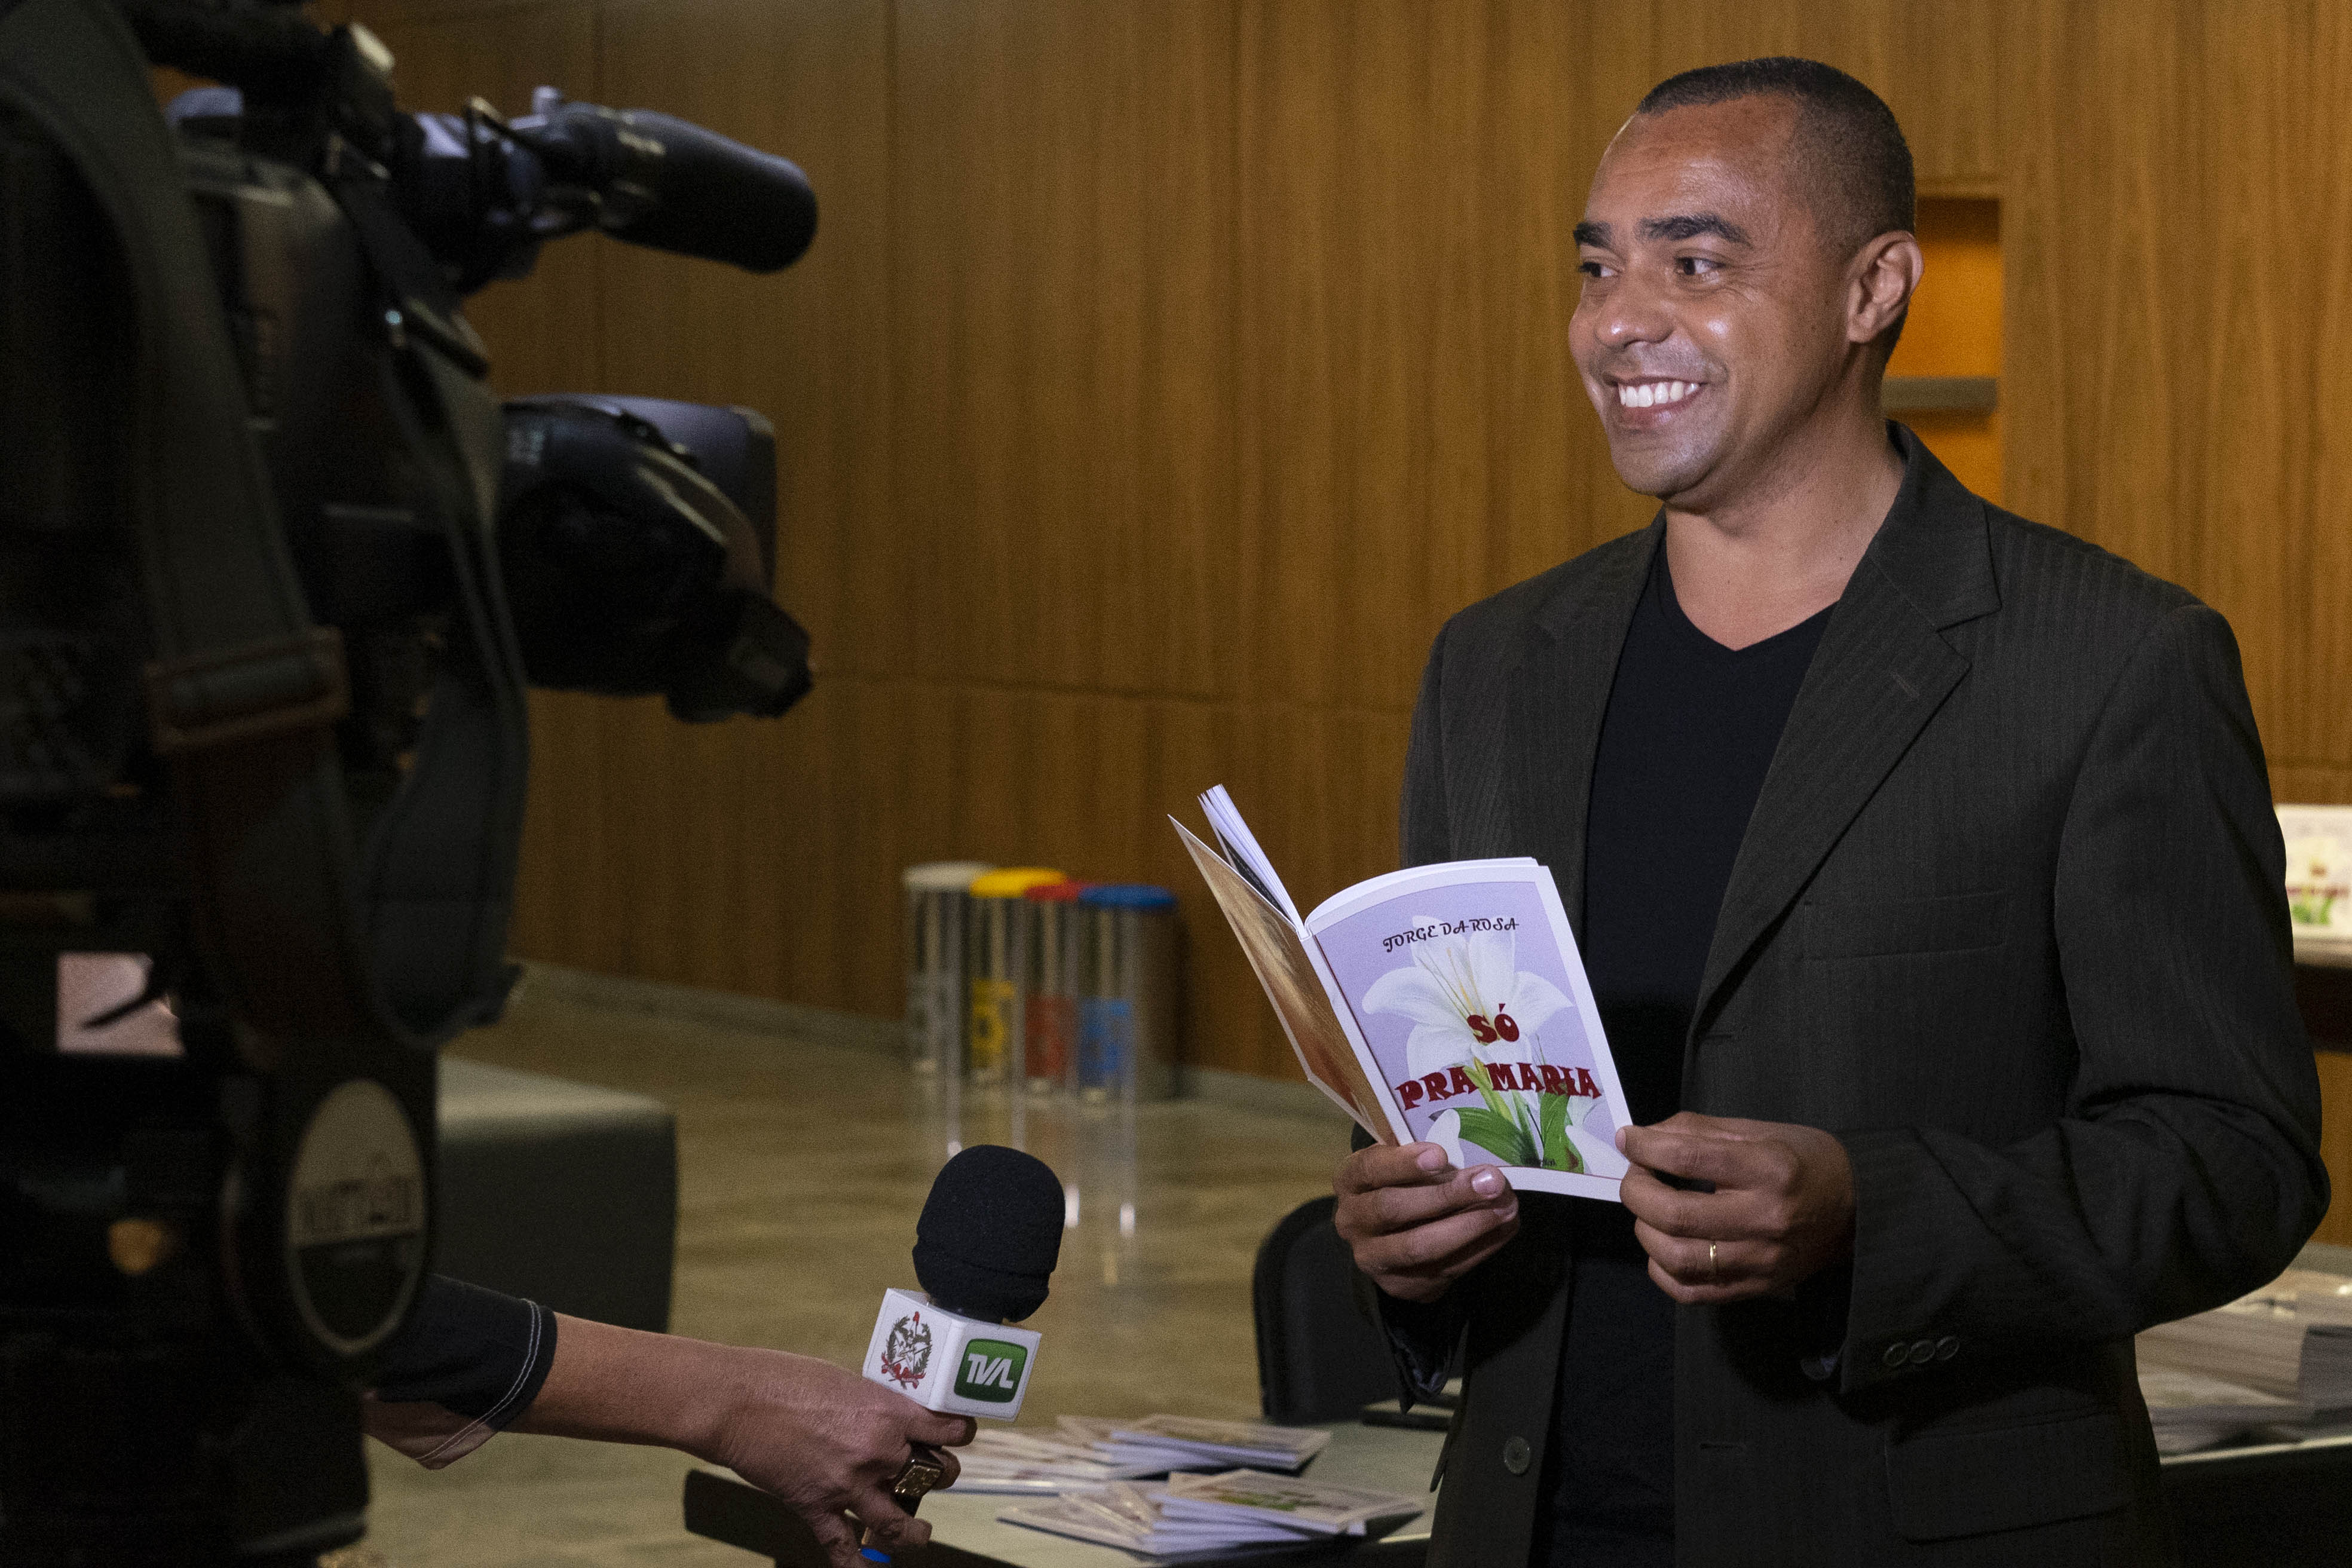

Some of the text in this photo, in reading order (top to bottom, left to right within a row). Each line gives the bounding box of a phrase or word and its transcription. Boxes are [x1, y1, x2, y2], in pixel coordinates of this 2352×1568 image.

[1382, 918, 1520, 953] JORGE DA ROSA
[1467, 1003, 1520, 1043] SÓ
[1395, 1062, 1603, 1111] PRA MARIA
